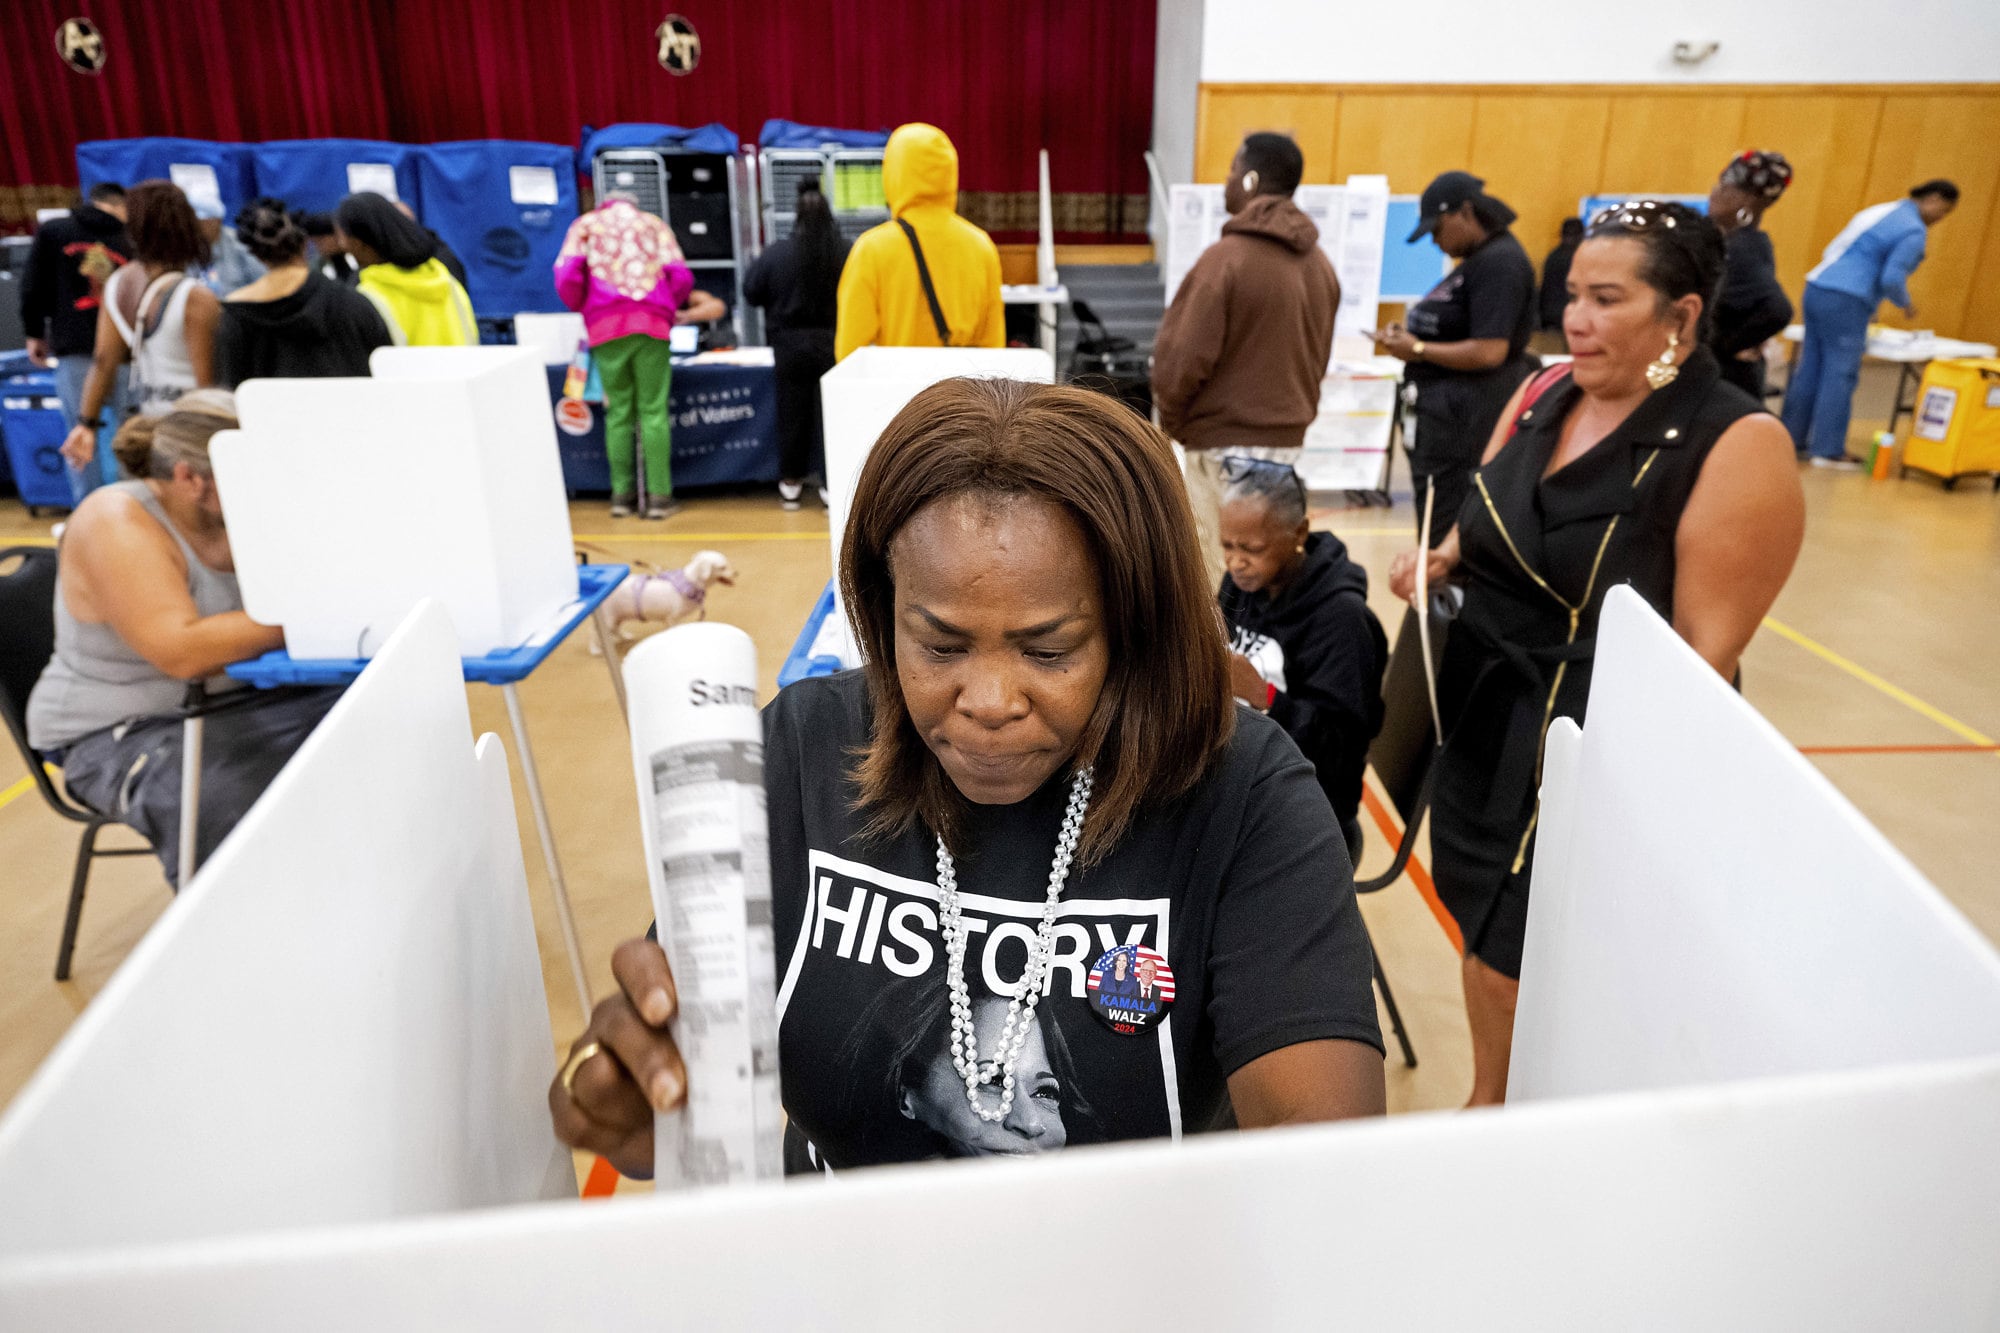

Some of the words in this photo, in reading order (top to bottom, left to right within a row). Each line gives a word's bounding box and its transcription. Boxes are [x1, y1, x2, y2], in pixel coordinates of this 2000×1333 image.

[679, 406, 698, 428] of
[698, 403, 756, 425] Voters
[1100, 993, 1157, 1014] KAMALA
[1108, 1008, 1147, 1025] WALZ
[1114, 1023, 1136, 1034] 2024
